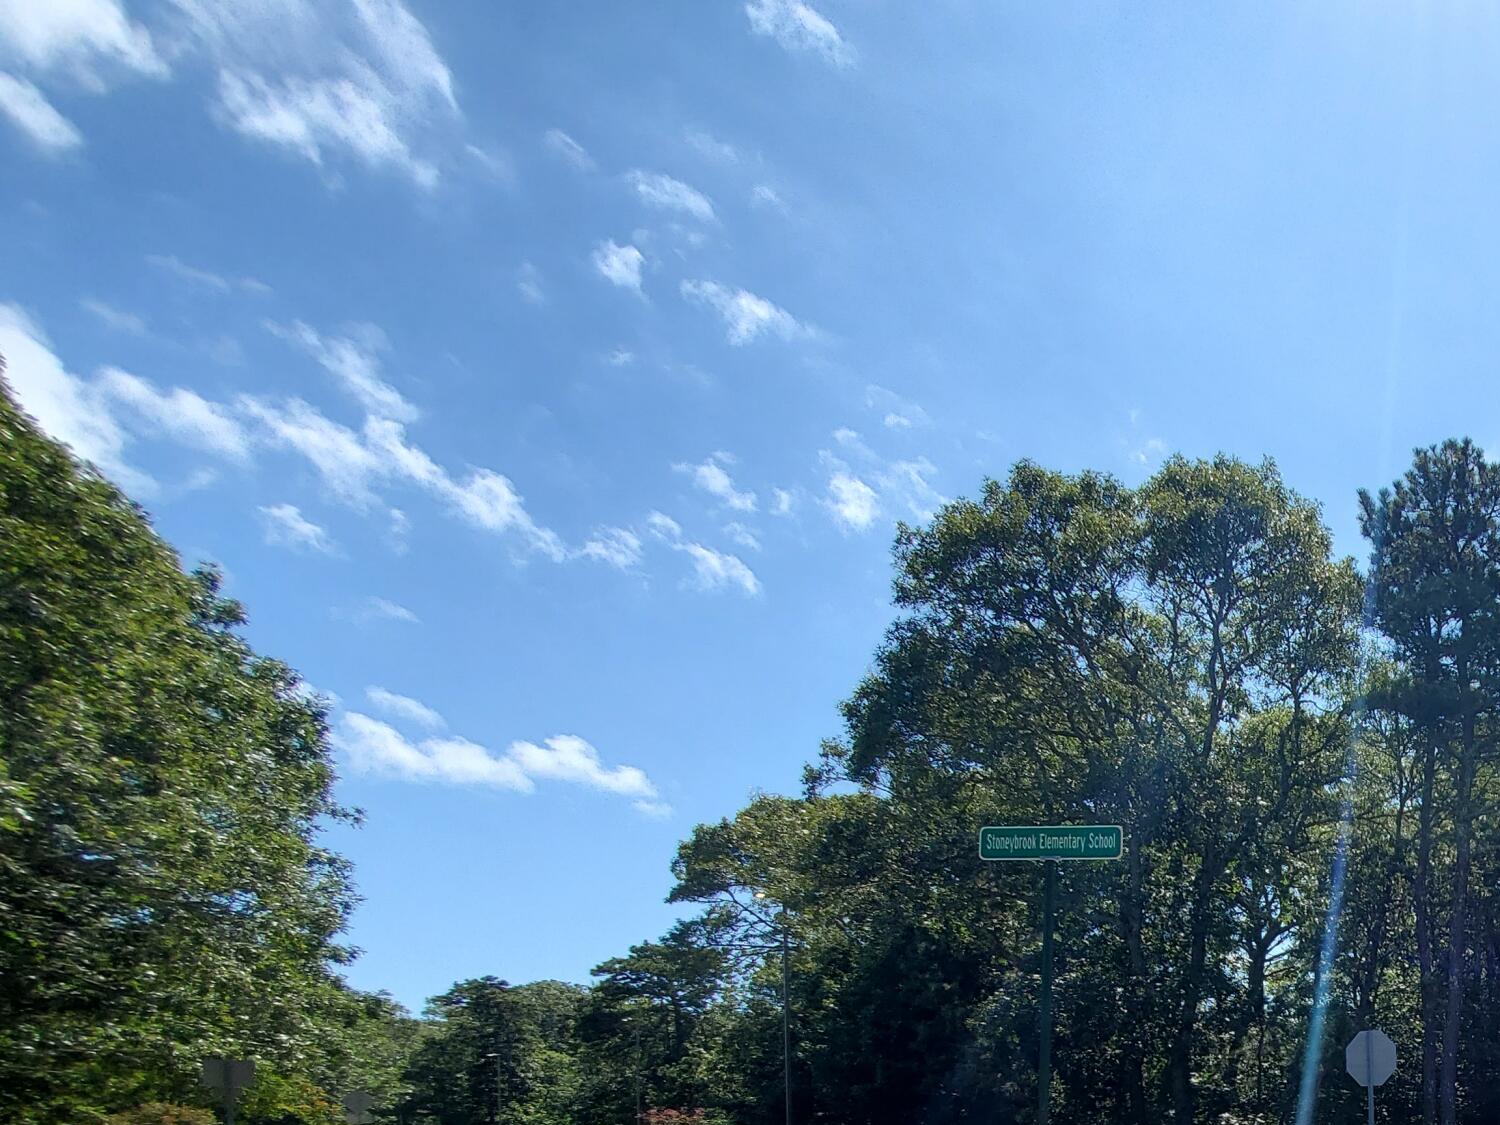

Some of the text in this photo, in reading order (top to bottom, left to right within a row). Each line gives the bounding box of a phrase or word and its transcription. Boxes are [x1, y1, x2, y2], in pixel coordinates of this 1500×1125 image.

[986, 832, 1116, 853] Stoneybrook Elementary School
